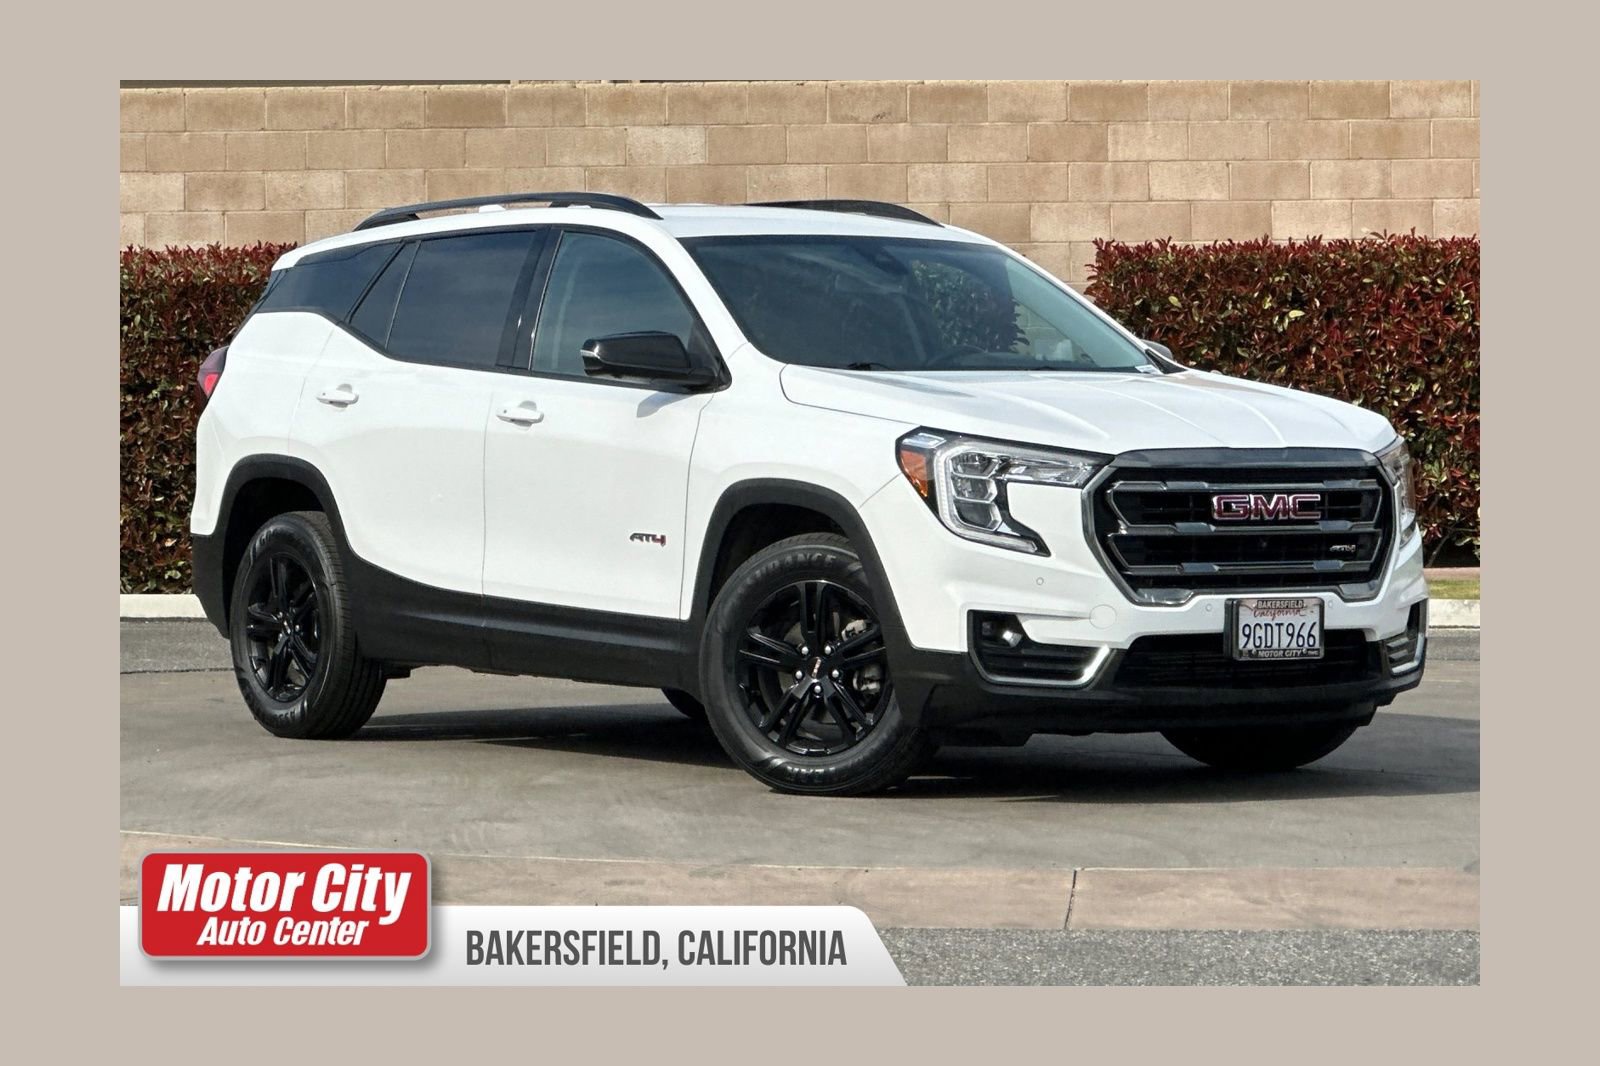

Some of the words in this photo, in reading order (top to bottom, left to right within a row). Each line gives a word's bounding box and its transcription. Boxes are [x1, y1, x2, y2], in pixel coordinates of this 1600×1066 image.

[1212, 494, 1321, 520] GMC
[629, 532, 666, 547] AT4
[1257, 600, 1304, 609] BAKERSFIELD
[1241, 621, 1318, 649] 9GDT966
[1258, 650, 1284, 658] MOTOR
[1284, 649, 1302, 657] CITY
